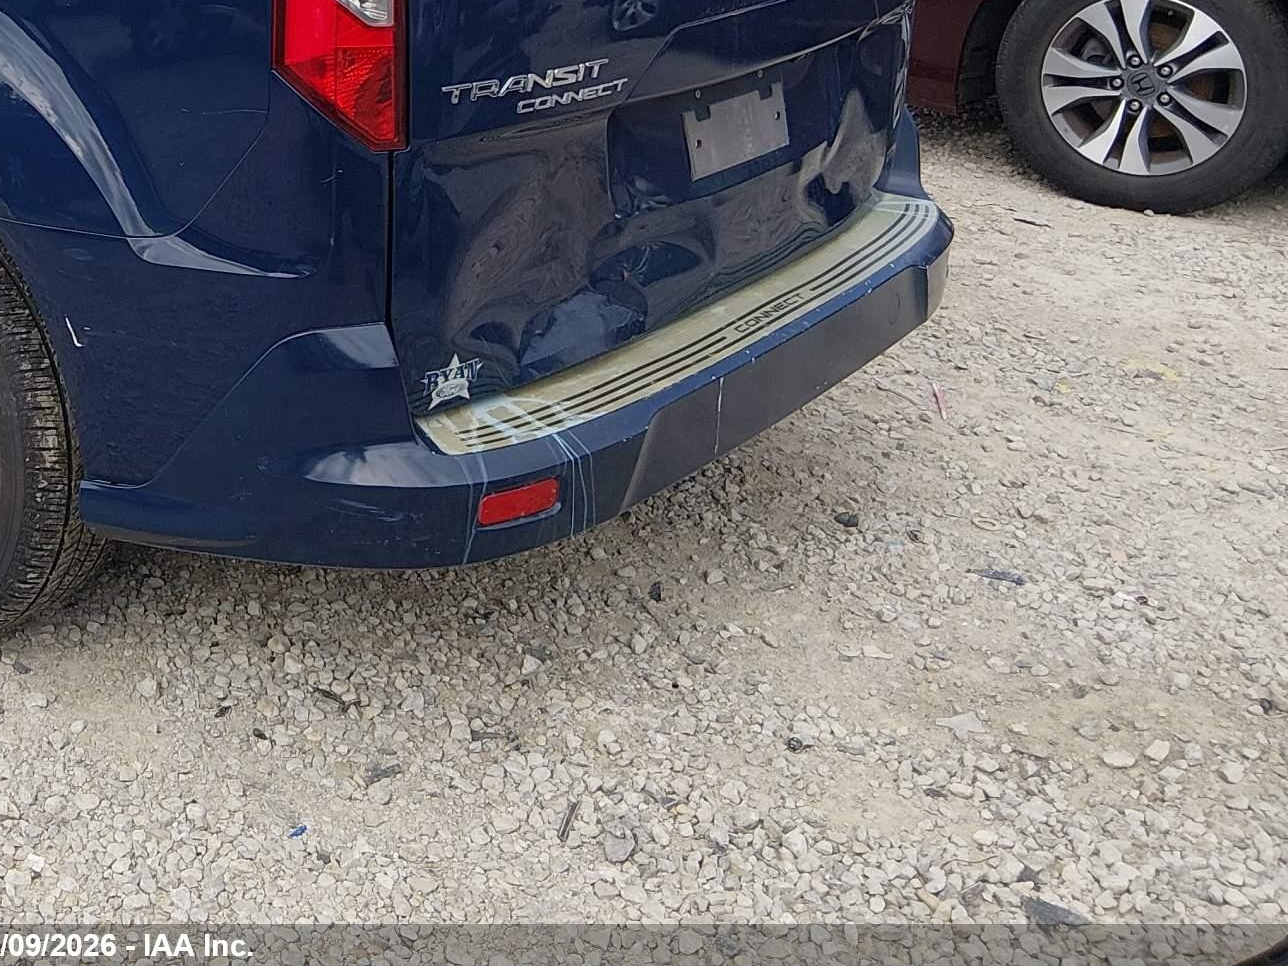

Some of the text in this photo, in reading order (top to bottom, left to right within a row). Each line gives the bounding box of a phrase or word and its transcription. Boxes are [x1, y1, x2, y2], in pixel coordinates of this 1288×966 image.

[441, 58, 609, 105] TRANSIT
[516, 78, 629, 114] CONNECT
[734, 293, 805, 333] CONNECT
[423, 358, 479, 397] RYAN
